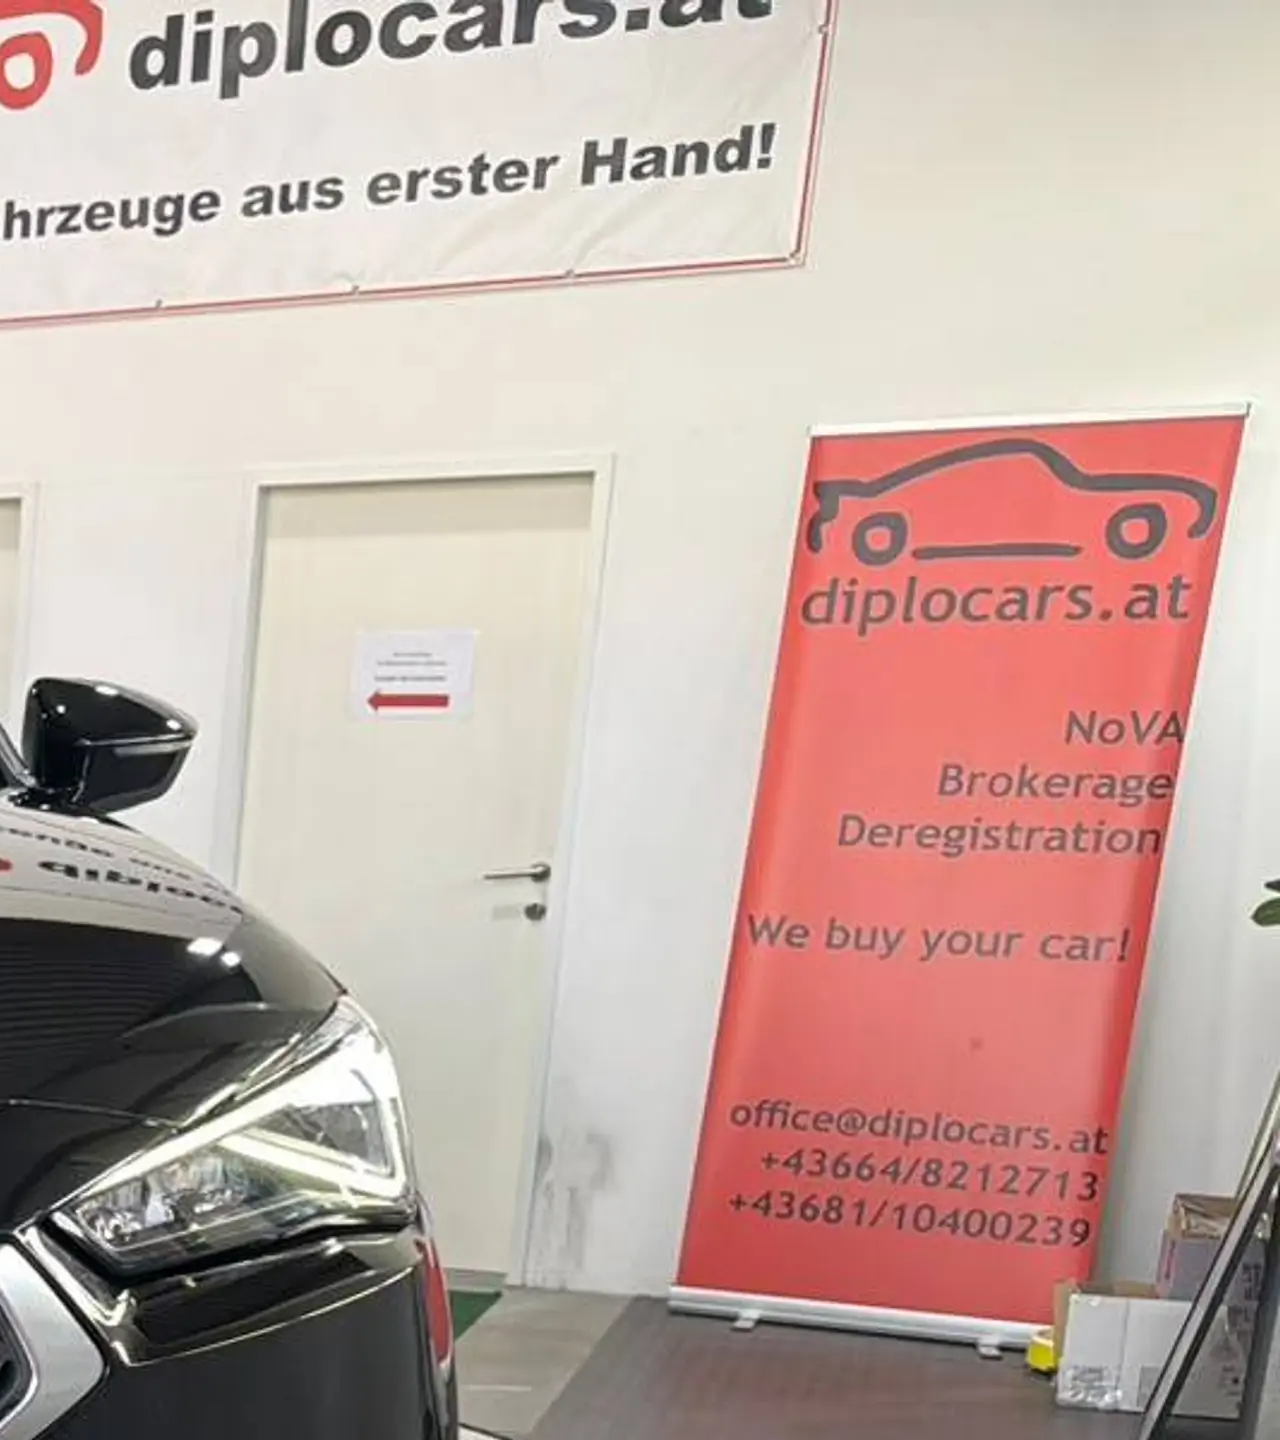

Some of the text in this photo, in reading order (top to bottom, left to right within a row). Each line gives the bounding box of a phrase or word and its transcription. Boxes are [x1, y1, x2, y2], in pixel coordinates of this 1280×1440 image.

[241, 175, 344, 219] aus
[366, 149, 560, 206] erster
[580, 122, 777, 186] Hand!
[801, 573, 1193, 637] diplocars.at
[1065, 710, 1185, 745] NoVA
[937, 763, 1176, 807] Brokerage
[837, 814, 1164, 858] Deregistration
[747, 914, 1132, 962] We buy your car!
[729, 1099, 1109, 1156] office@diplocars.at
[761, 1148, 1100, 1202] +43664/8212713
[727, 1190, 1093, 1248] +43681/10400239
